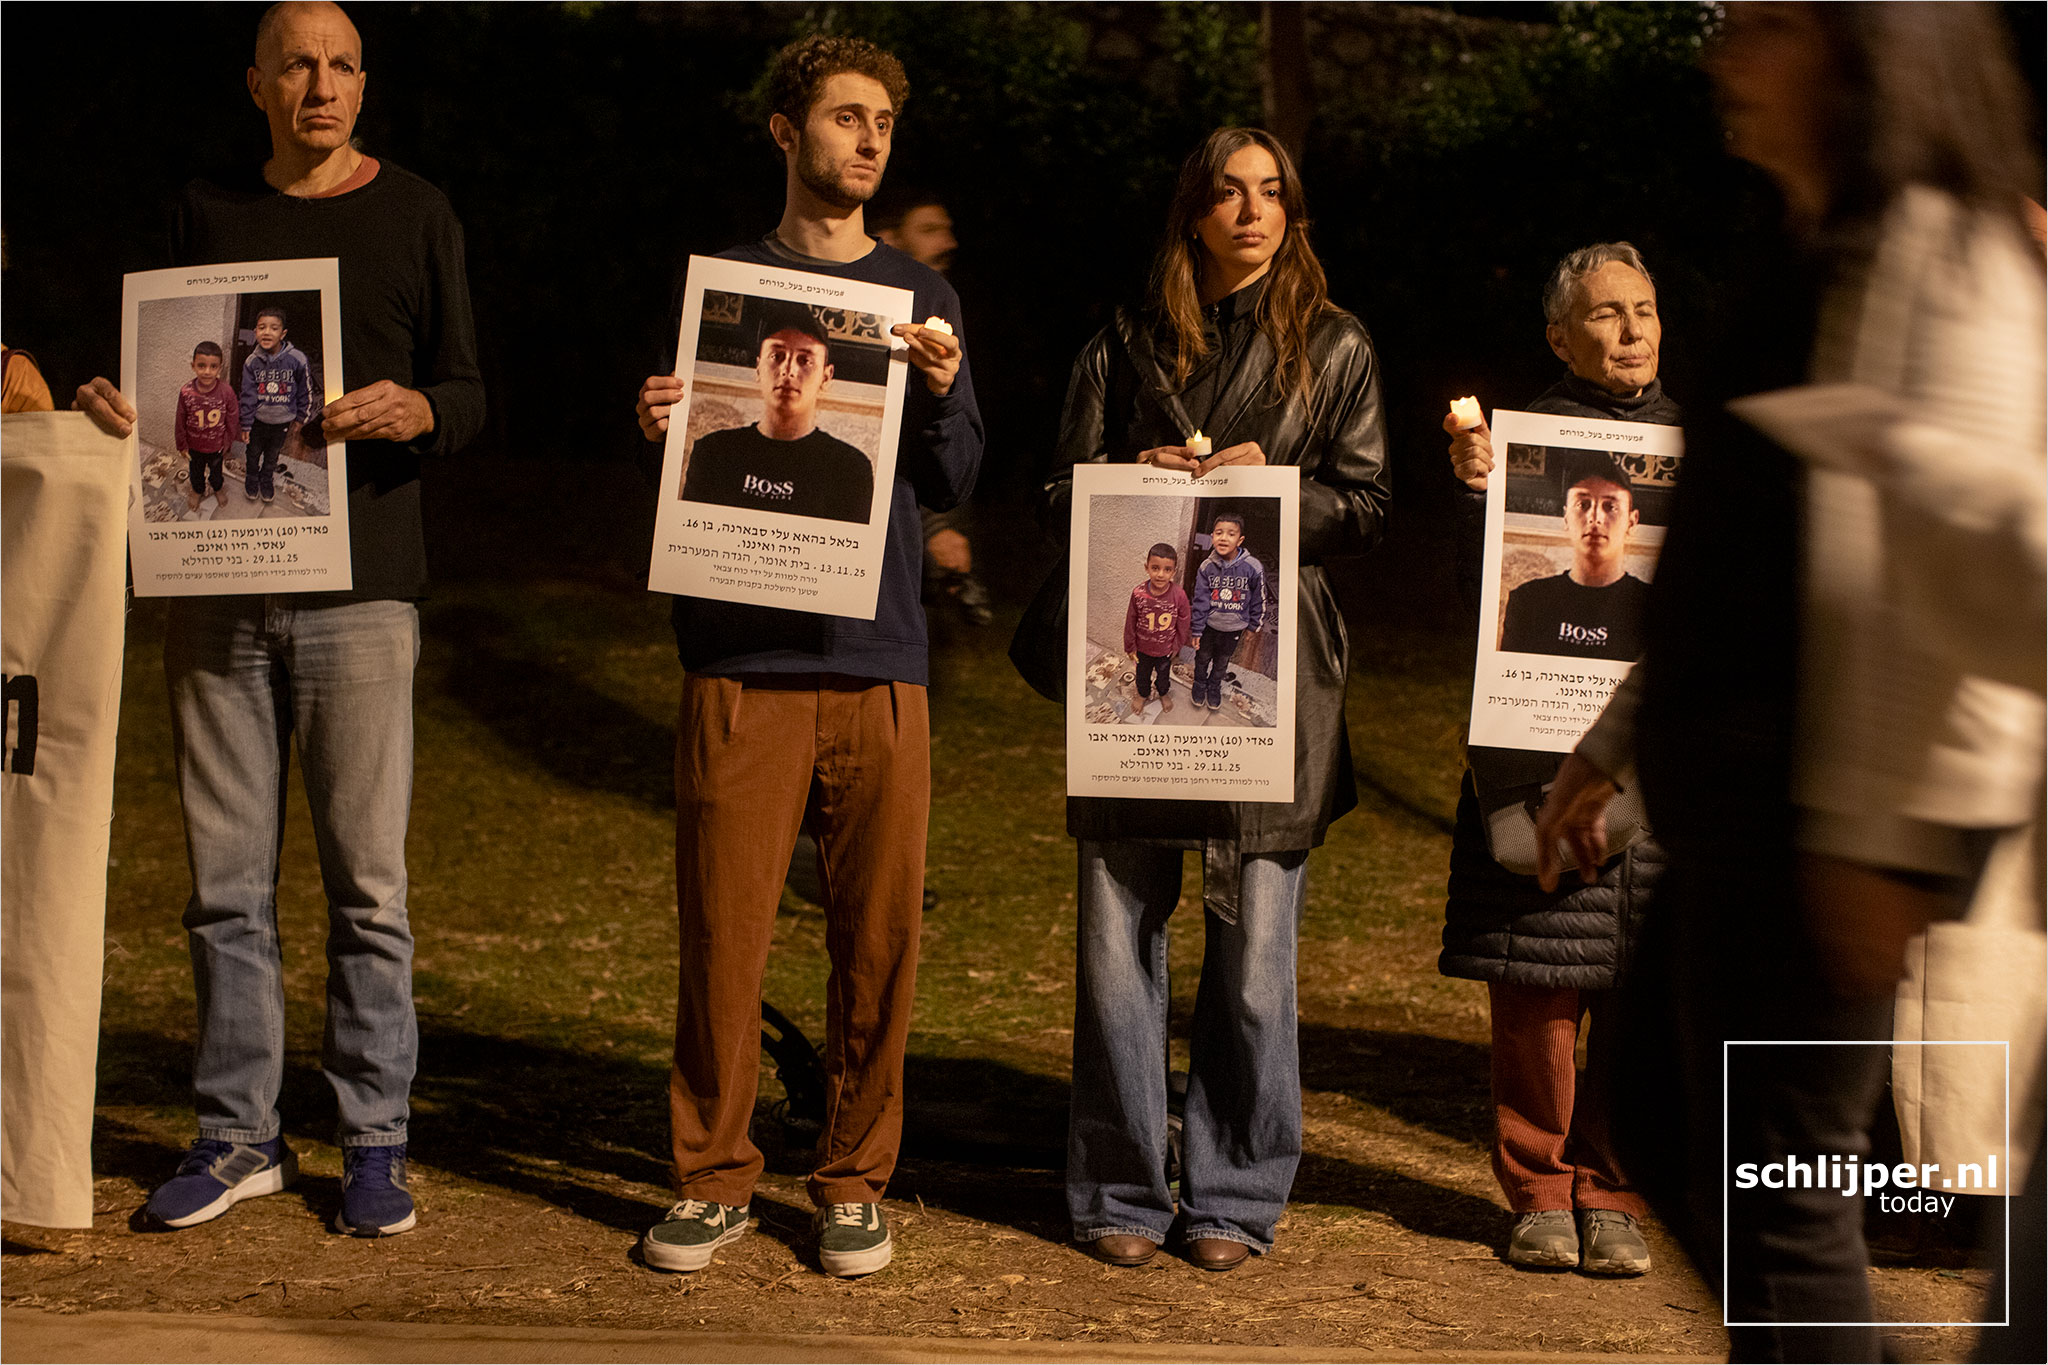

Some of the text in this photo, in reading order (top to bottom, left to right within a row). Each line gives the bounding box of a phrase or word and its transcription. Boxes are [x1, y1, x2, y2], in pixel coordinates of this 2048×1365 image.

[194, 409, 222, 428] 19
[744, 474, 794, 495] BOSS
[148, 531, 169, 541] אבו
[170, 530, 204, 540] תאמר
[206, 528, 228, 541] (12)
[276, 525, 299, 538] (10)
[300, 525, 329, 535] פאדי
[682, 518, 859, 550] בלאל בהאא עלי סבארנה, בן 16.
[192, 540, 286, 553] עאסי. היו ואינם.
[737, 539, 801, 556] היה ואיננו.
[181, 553, 299, 567] 29.11.25 בני סוהילא
[667, 543, 866, 578] 13.11.25 בית אומר, הגדה המערבית
[1145, 612, 1172, 631] 19
[1560, 622, 1608, 641] BOSS
[1501, 668, 1518, 679] 16.
[1520, 670, 1532, 682] בן
[1535, 671, 1585, 684] סבארנה,
[1587, 674, 1607, 687] עלי
[1555, 687, 1593, 699] ואיננו.
[1487, 695, 1539, 708] המערבית
[1541, 699, 1570, 711] הגדה
[1087, 732, 1109, 742] אבו
[1111, 733, 1146, 743] תאמר
[1148, 733, 1171, 746] (12)
[1220, 735, 1243, 748] (10)
[1245, 736, 1274, 747] פאדי
[1132, 747, 1230, 760] עאסי. היו ואינם.
[1119, 758, 1241, 773] 29.11.25 בני סוהילא
